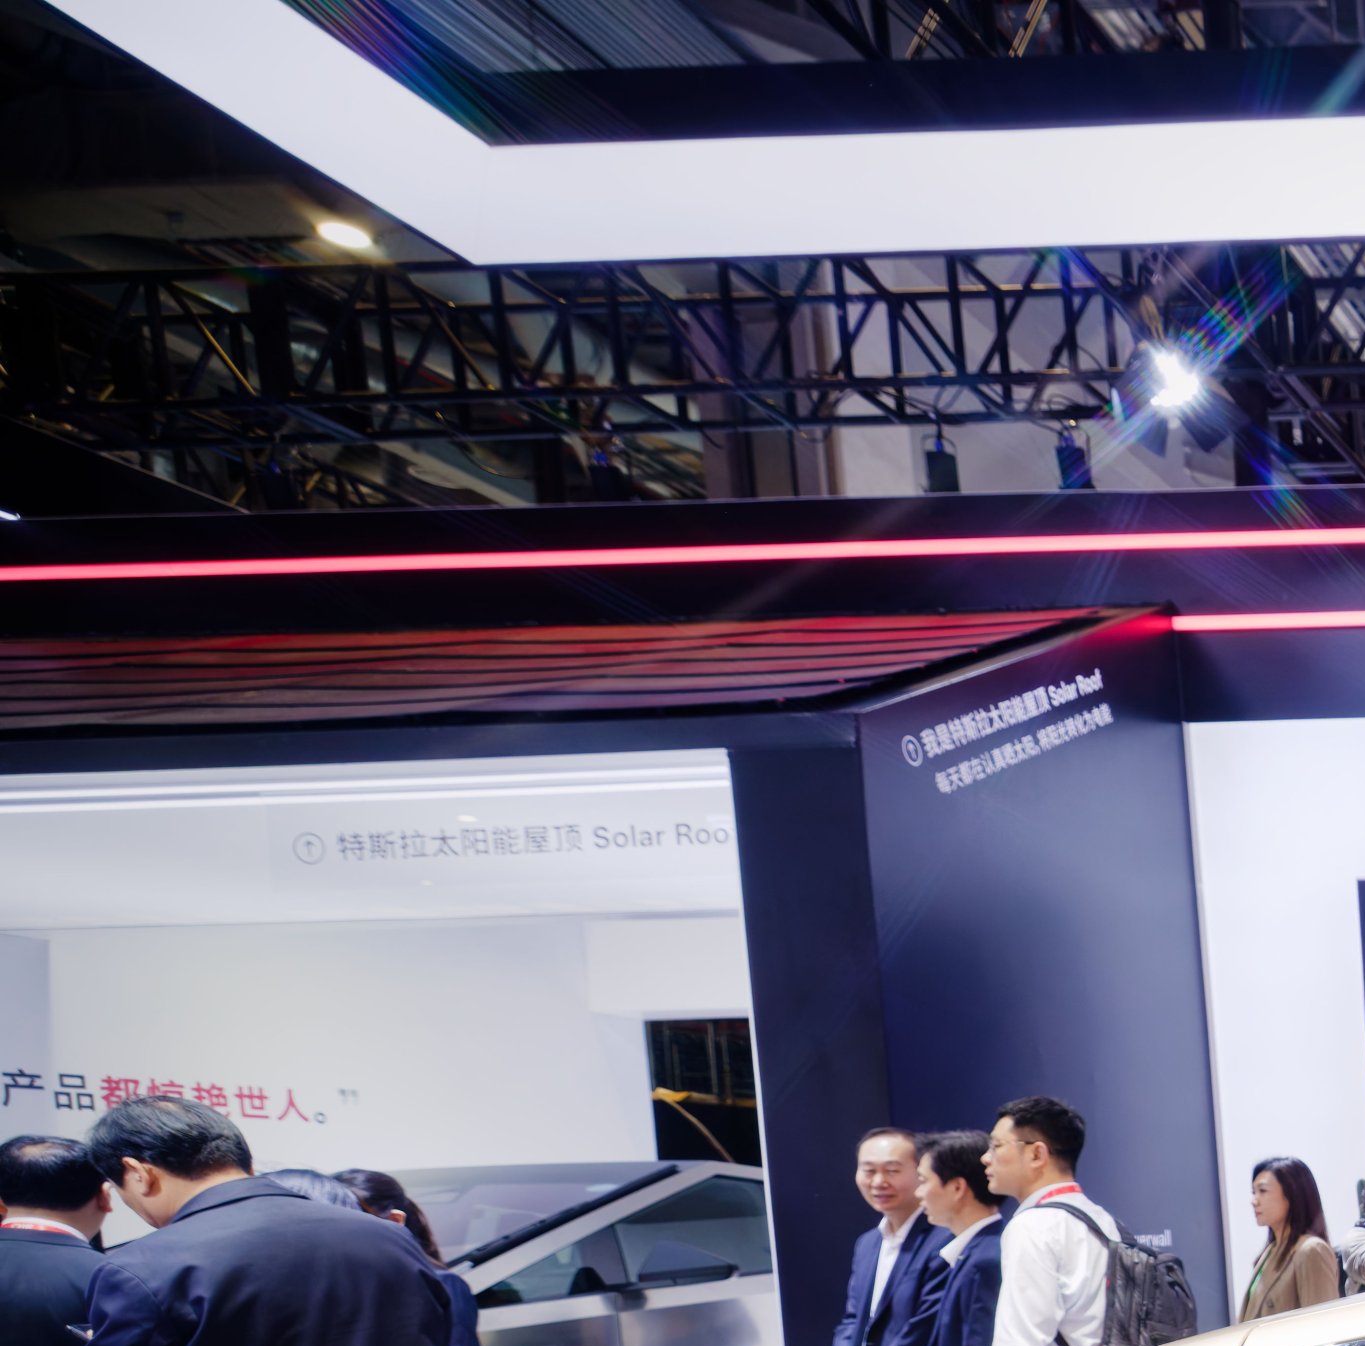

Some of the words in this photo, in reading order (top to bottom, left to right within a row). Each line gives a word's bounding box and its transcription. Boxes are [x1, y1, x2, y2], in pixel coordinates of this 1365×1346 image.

[1048, 681, 1079, 707] Solar
[1075, 667, 1104, 696] Roof
[335, 824, 583, 861] 特斯拉太阳能屋顶
[593, 823, 665, 850] Solar
